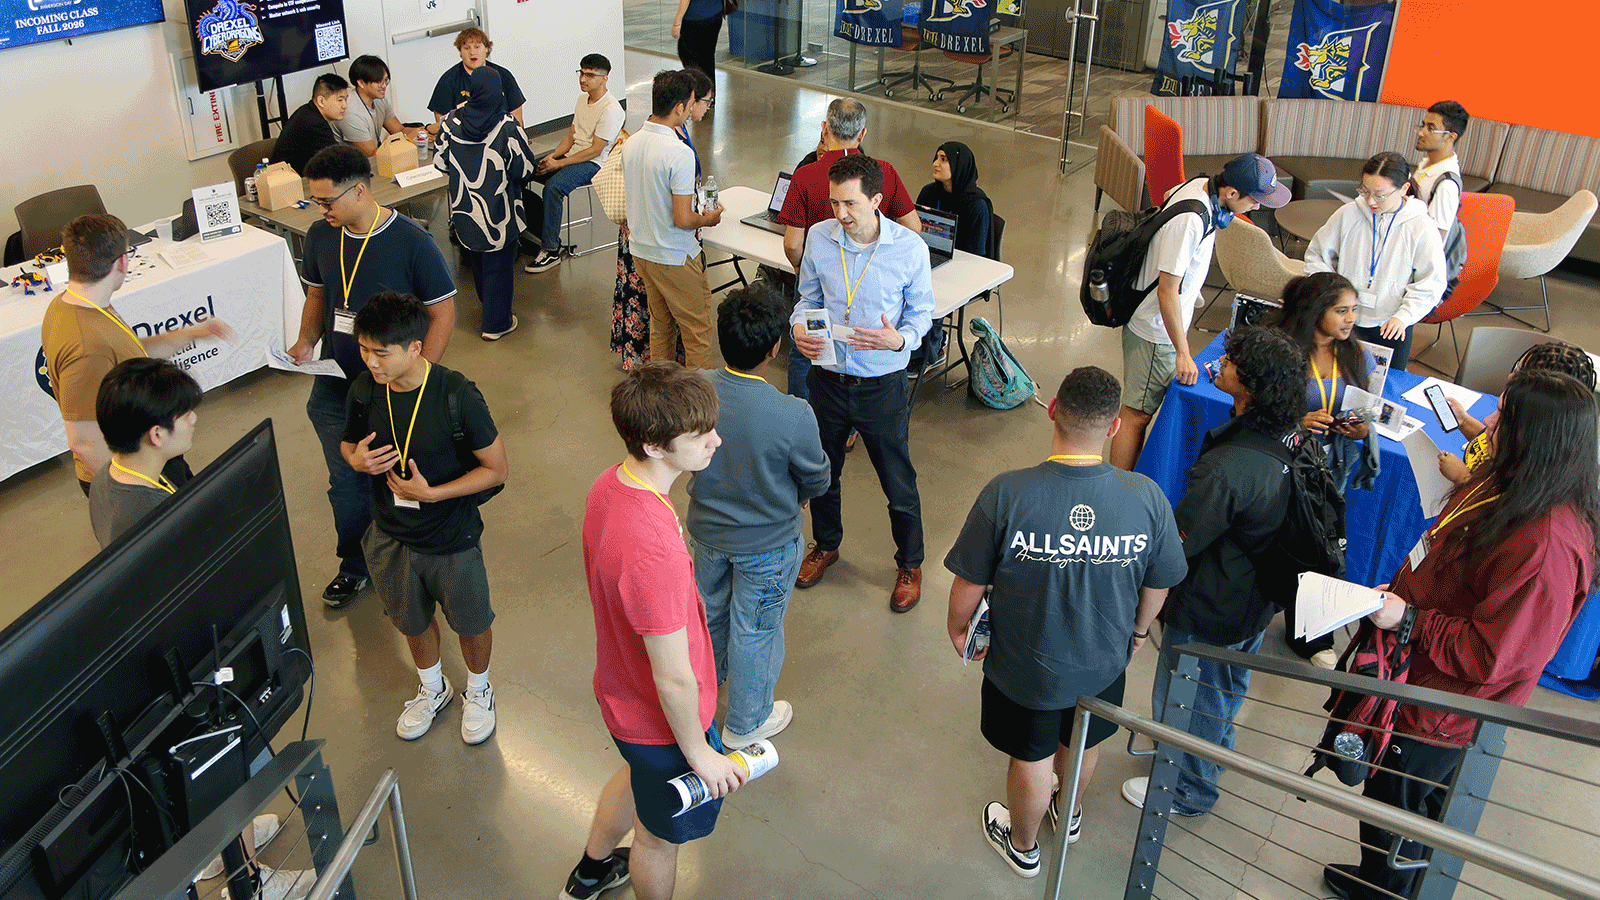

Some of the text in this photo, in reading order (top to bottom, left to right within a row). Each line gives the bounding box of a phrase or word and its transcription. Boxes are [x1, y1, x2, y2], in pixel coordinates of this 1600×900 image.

[15, 7, 99, 29] INCOMING CLASS
[36, 19, 85, 35] FALL 2026
[210, 18, 250, 34] DREXEL
[203, 27, 264, 53] CYBERDRAGONS
[853, 24, 894, 44] DREXEL
[940, 33, 985, 53] DREXEL
[209, 91, 224, 143] FIRE EXTIN
[132, 295, 215, 337] Drexel
[1010, 530, 1148, 556] ALLSAINTS
